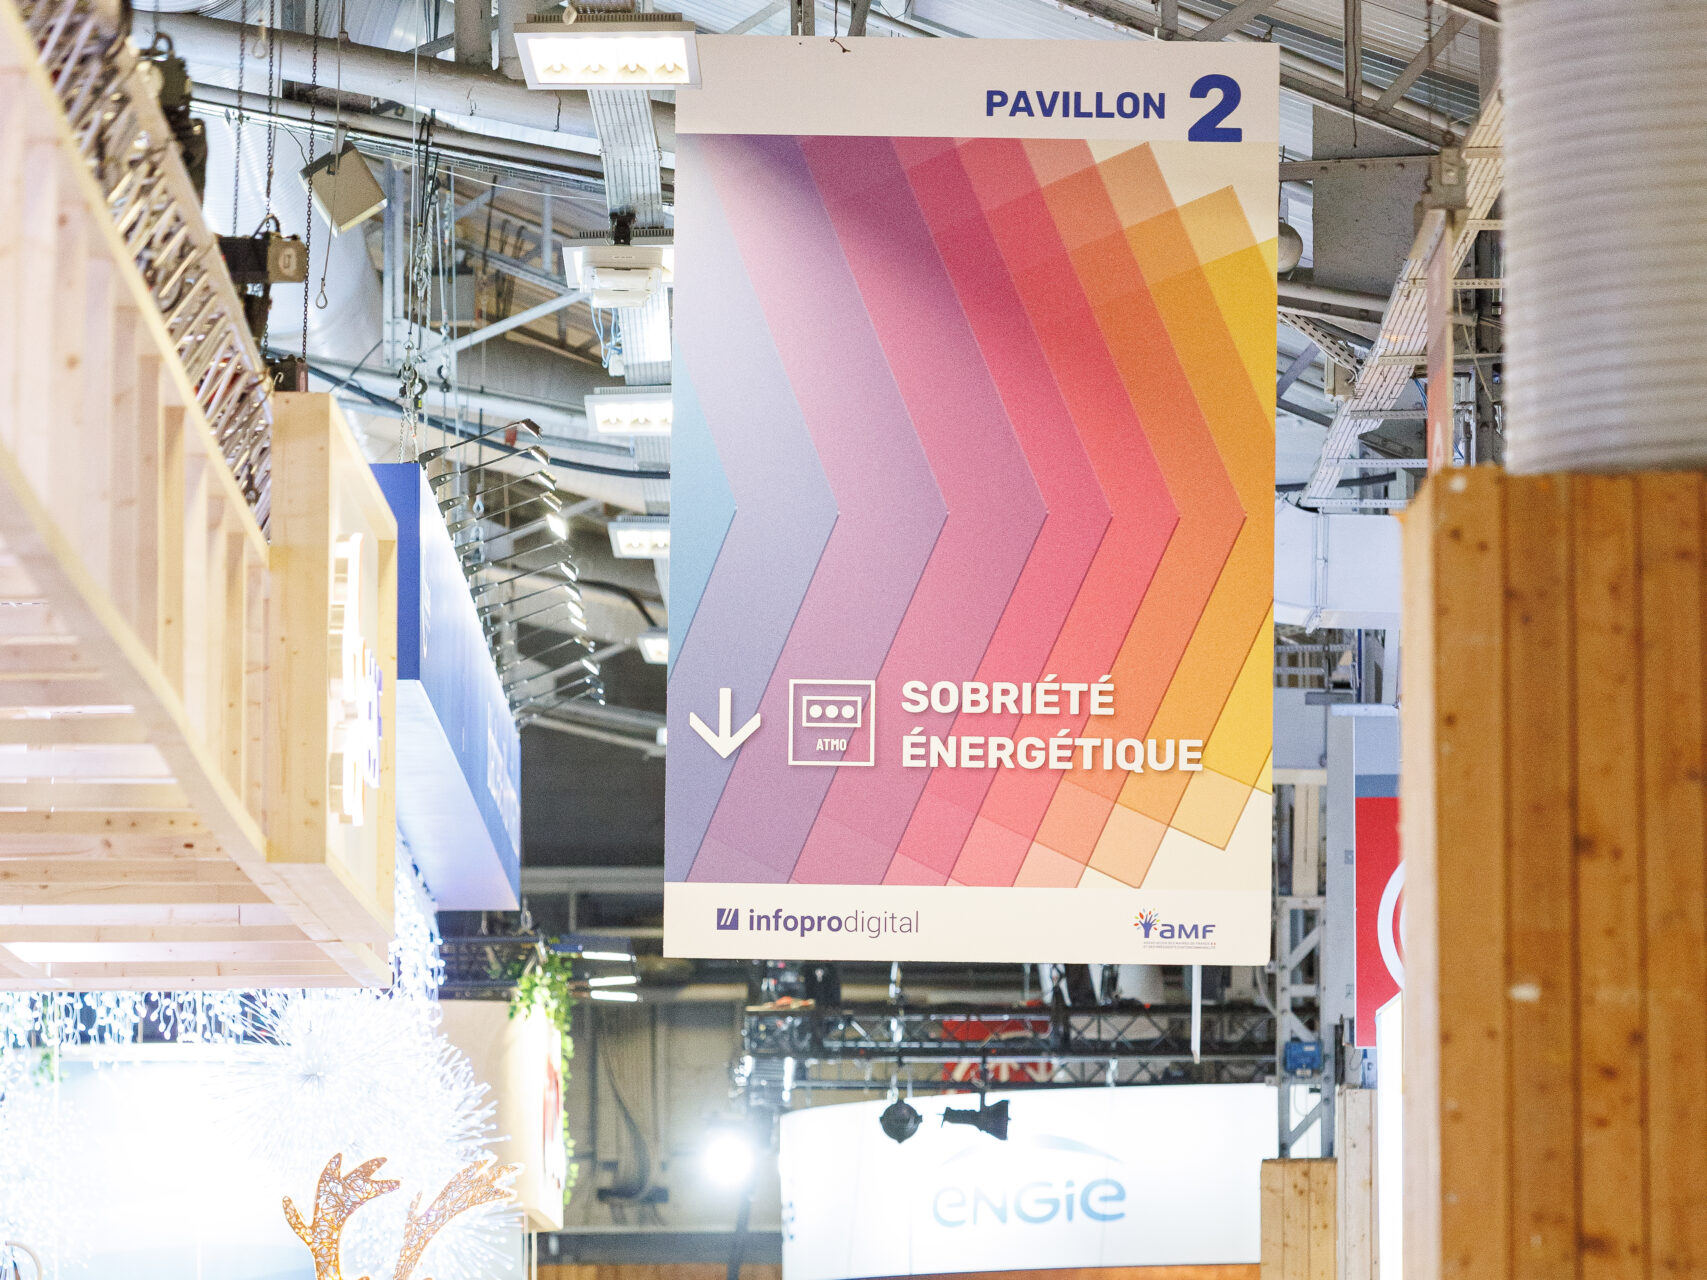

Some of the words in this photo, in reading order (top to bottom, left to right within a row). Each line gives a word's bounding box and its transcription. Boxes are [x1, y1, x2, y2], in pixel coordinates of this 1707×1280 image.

[986, 90, 1166, 119] PAVILLON
[1188, 74, 1243, 143] 2
[901, 674, 1115, 716] SOBRIÉTÉ
[816, 738, 847, 751] ATMO
[902, 726, 1204, 773] ÉNERGÉTIQUE
